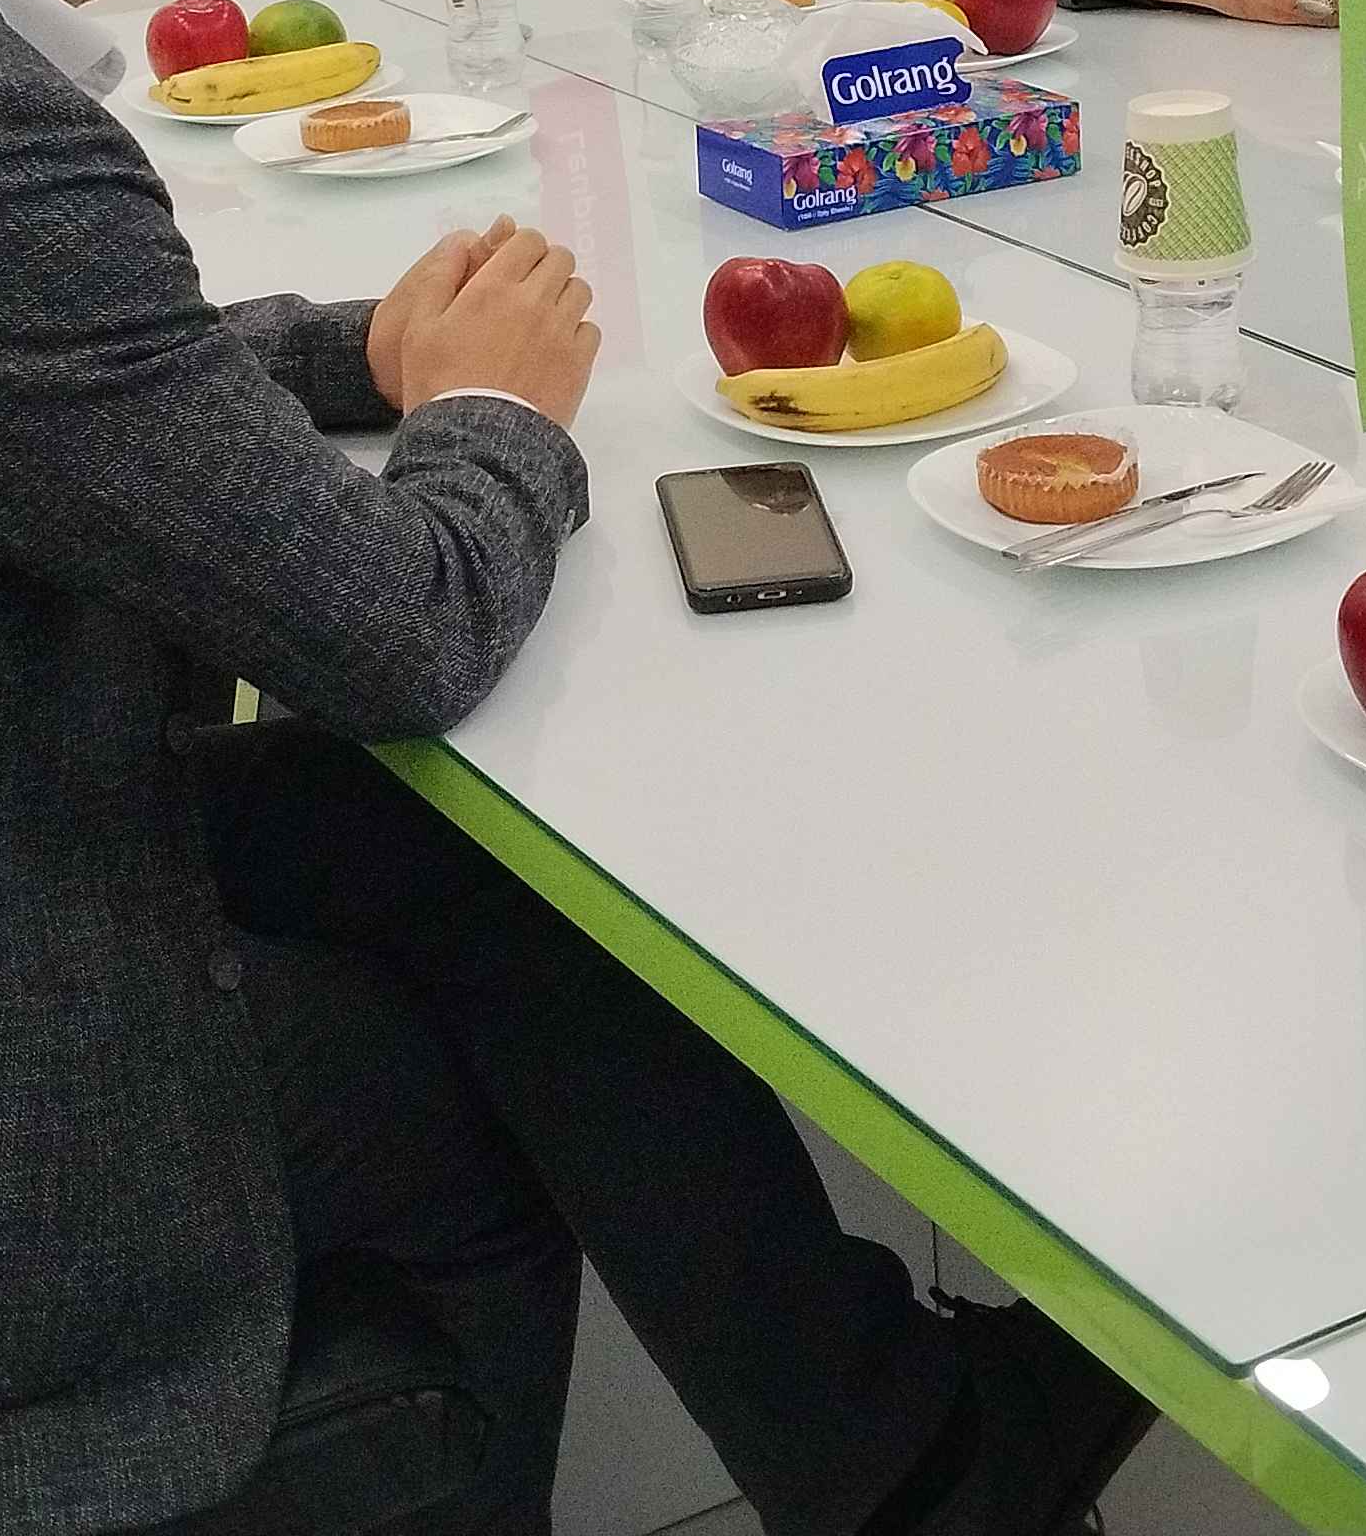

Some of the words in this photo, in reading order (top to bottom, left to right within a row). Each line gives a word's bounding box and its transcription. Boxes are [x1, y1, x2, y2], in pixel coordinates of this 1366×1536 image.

[831, 56, 958, 105] Golrang
[722, 158, 753, 185] Golrang
[793, 185, 857, 211] Golrang
